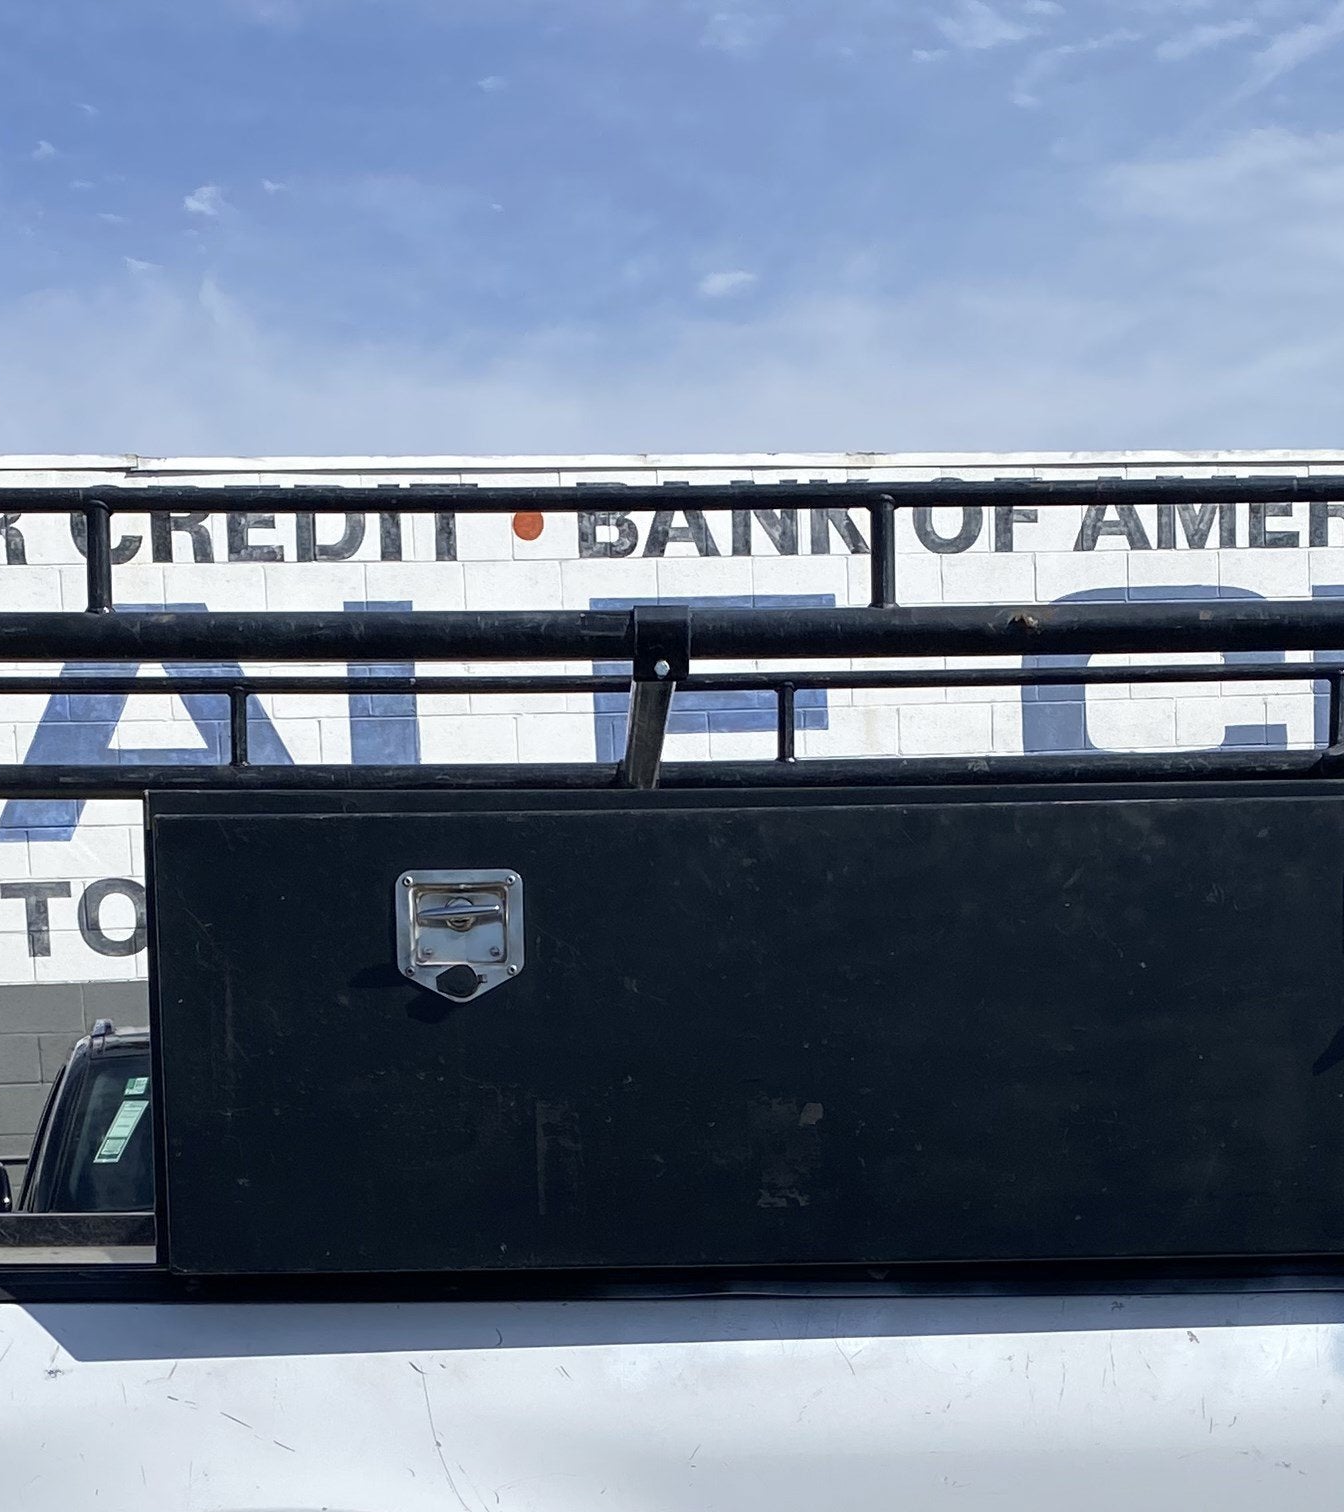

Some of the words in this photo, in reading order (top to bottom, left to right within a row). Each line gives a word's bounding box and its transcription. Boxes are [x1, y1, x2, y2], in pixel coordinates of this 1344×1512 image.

[71, 484, 479, 564] CREDIT
[575, 480, 872, 558] BANK
[912, 477, 1044, 553] OF
